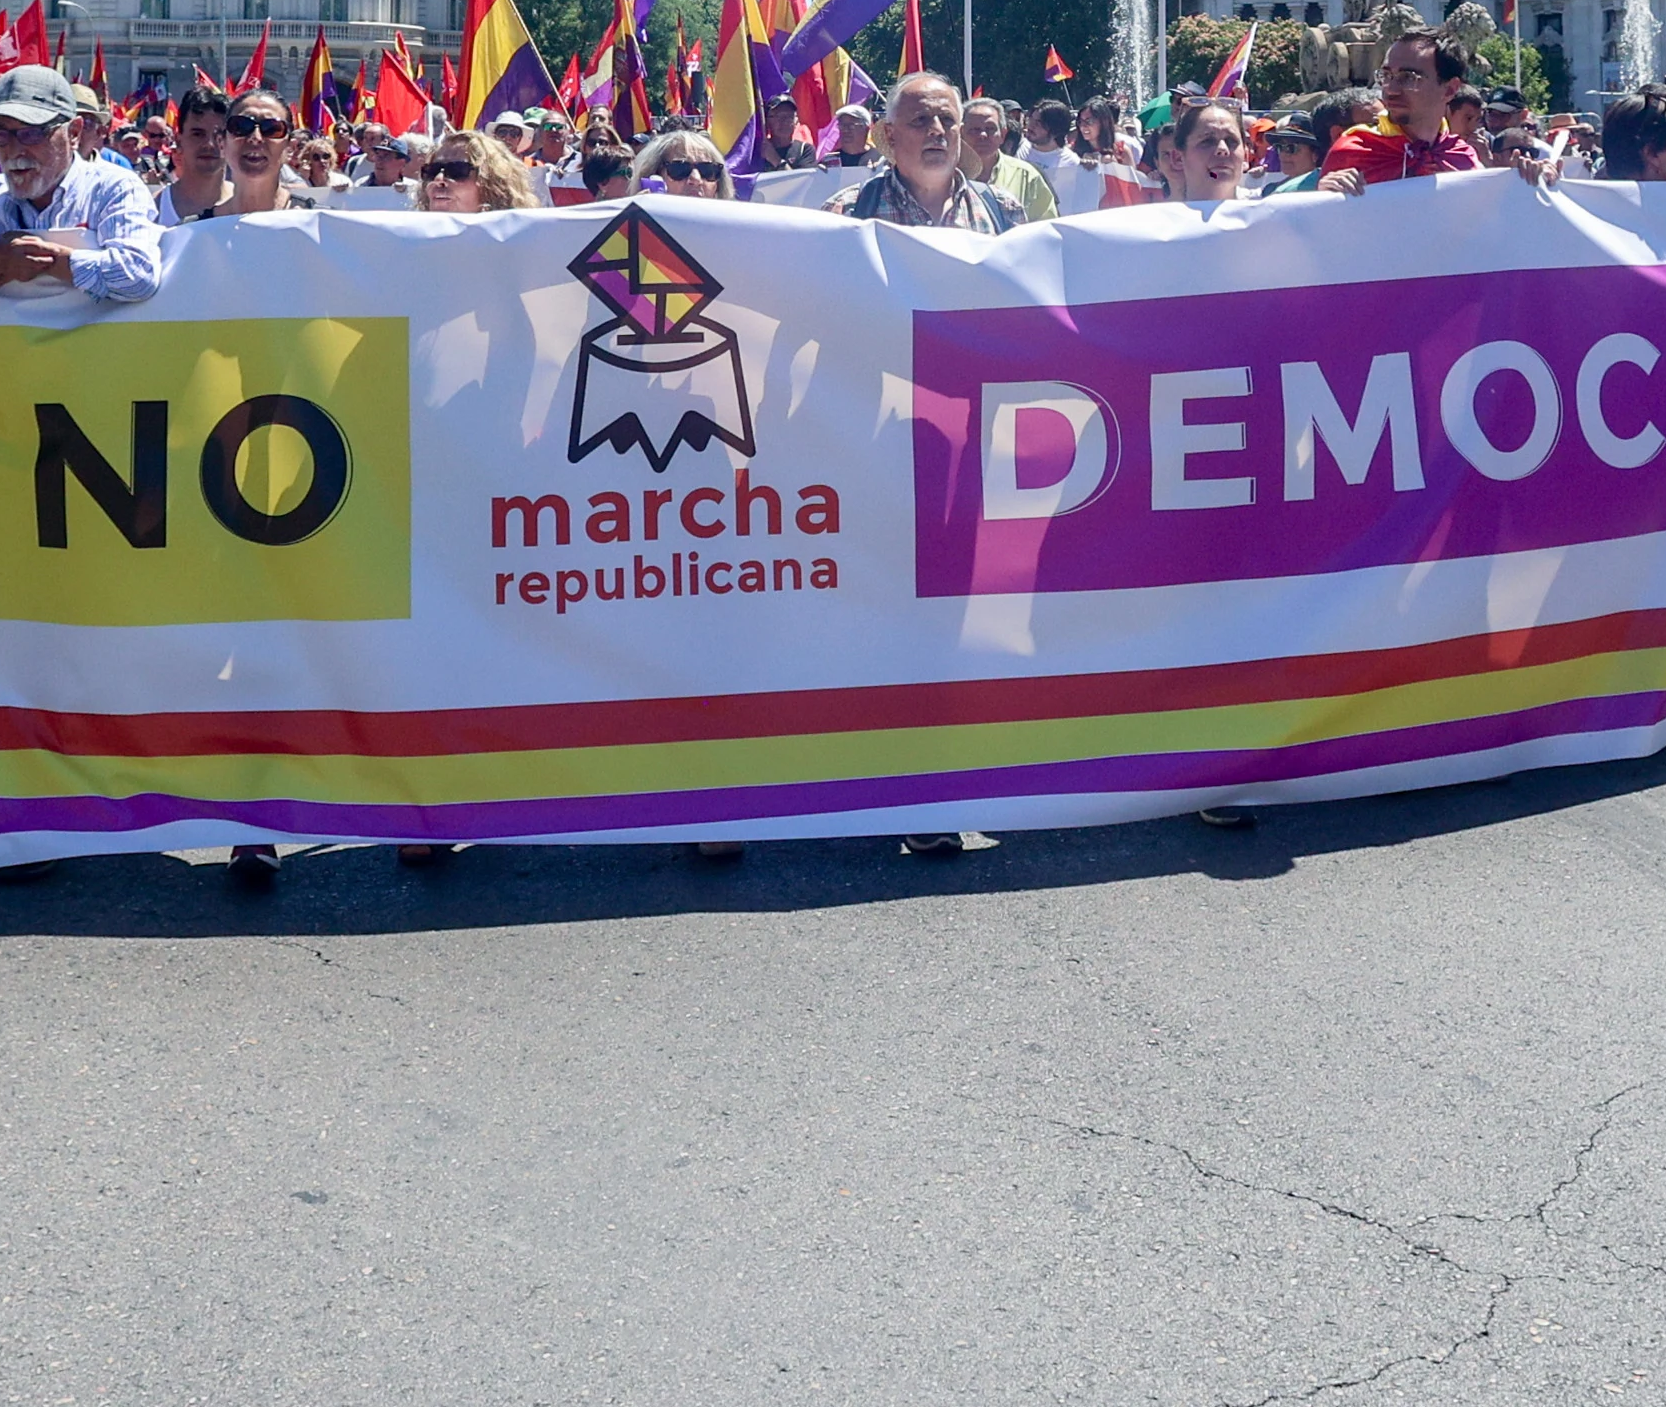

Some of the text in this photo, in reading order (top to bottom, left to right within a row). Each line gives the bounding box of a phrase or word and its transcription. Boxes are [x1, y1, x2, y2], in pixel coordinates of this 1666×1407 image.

[34, 393, 354, 549] NO
[491, 467, 841, 548] marcha
[495, 551, 839, 615] republicana
